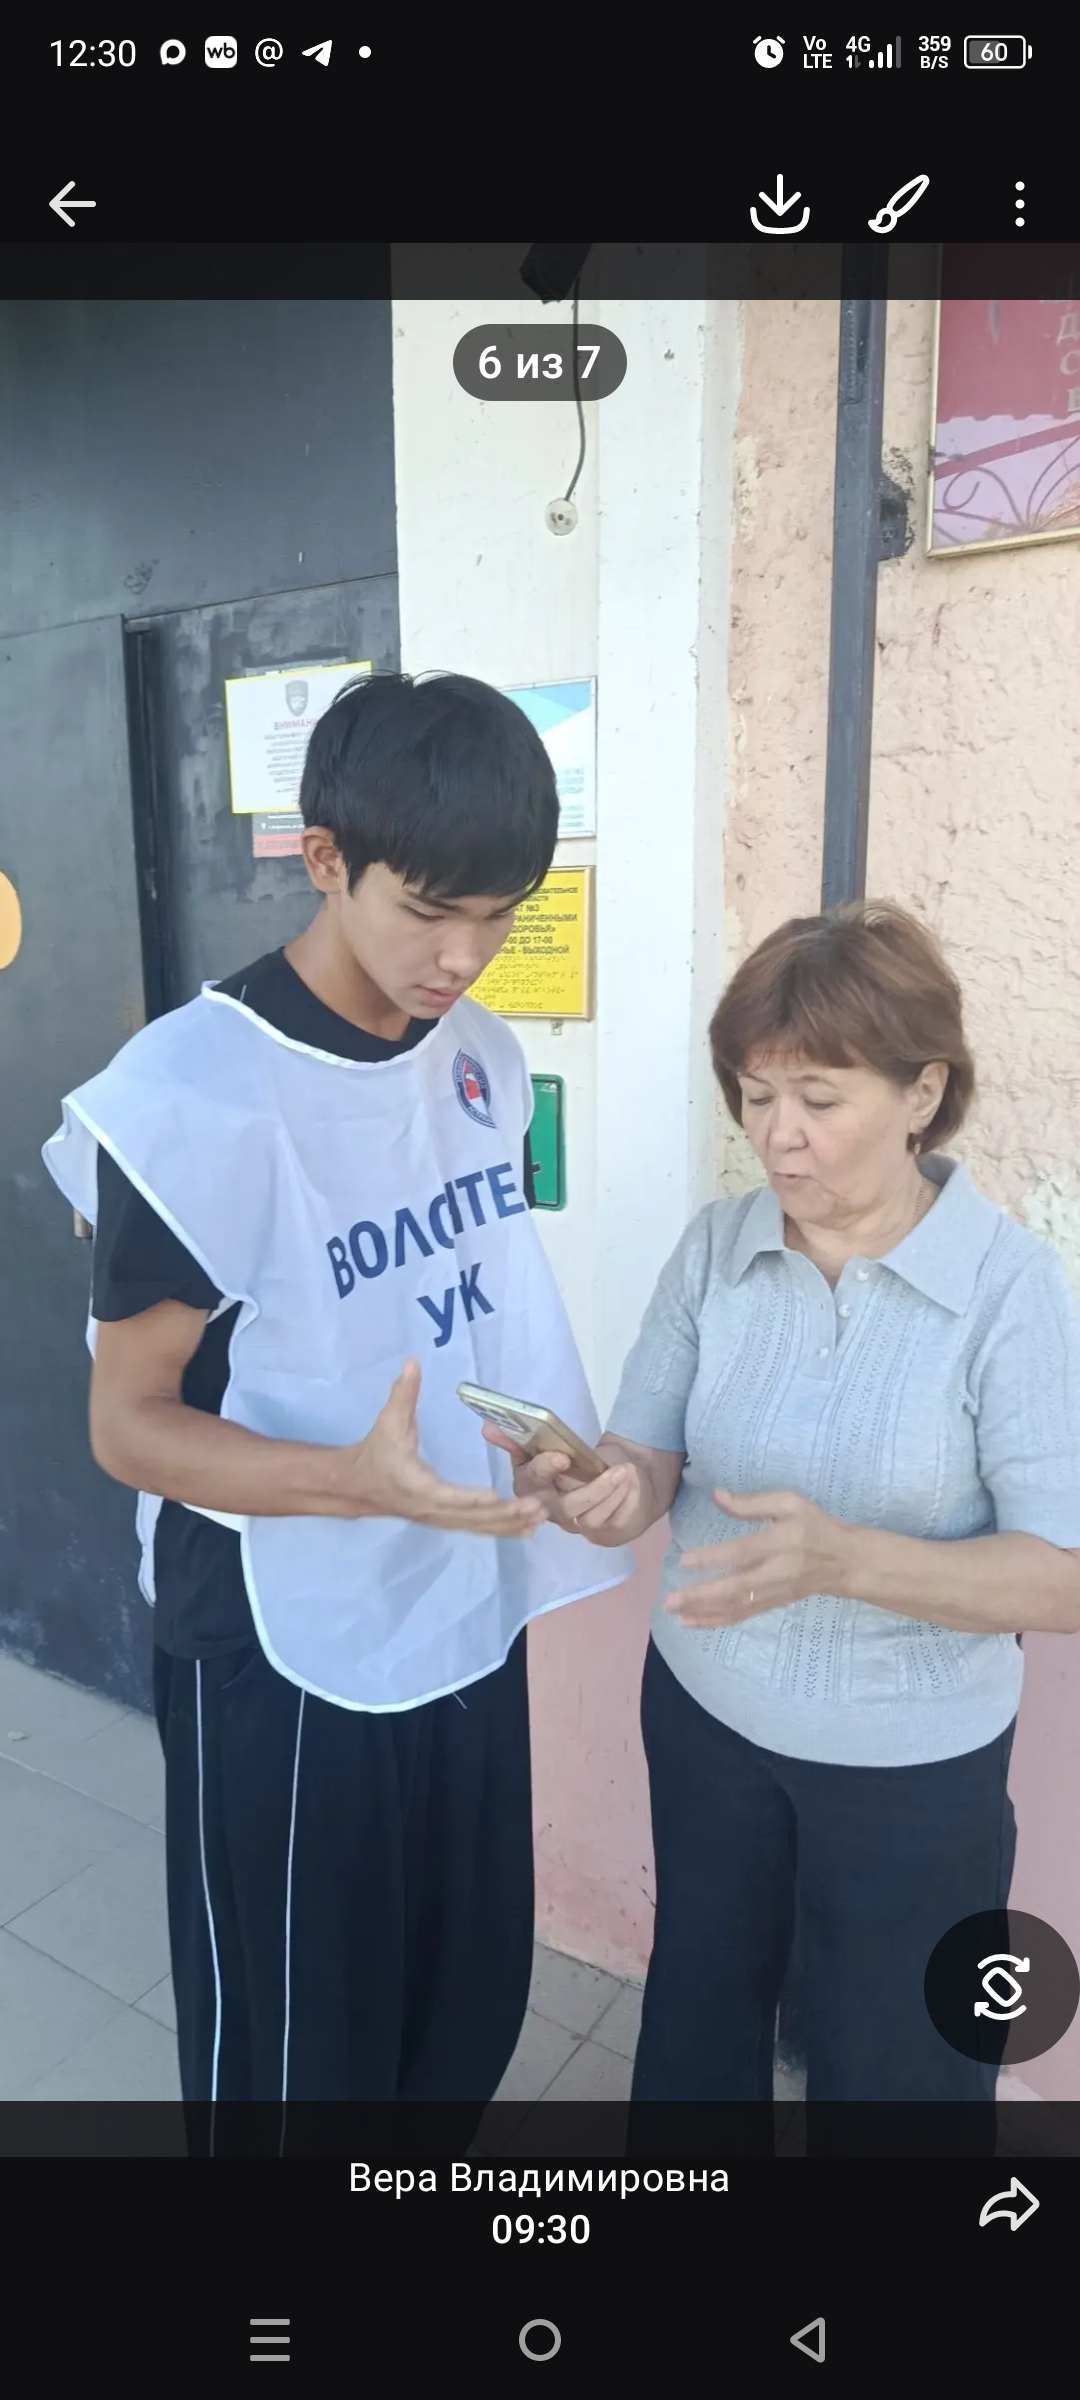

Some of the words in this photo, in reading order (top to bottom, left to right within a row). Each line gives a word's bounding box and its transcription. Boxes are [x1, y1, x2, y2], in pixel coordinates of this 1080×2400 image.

[519, 936, 531, 945] ДО
[522, 944, 570, 955] ВЫХОДНОЙ
[416, 1262, 496, 1349] УК
